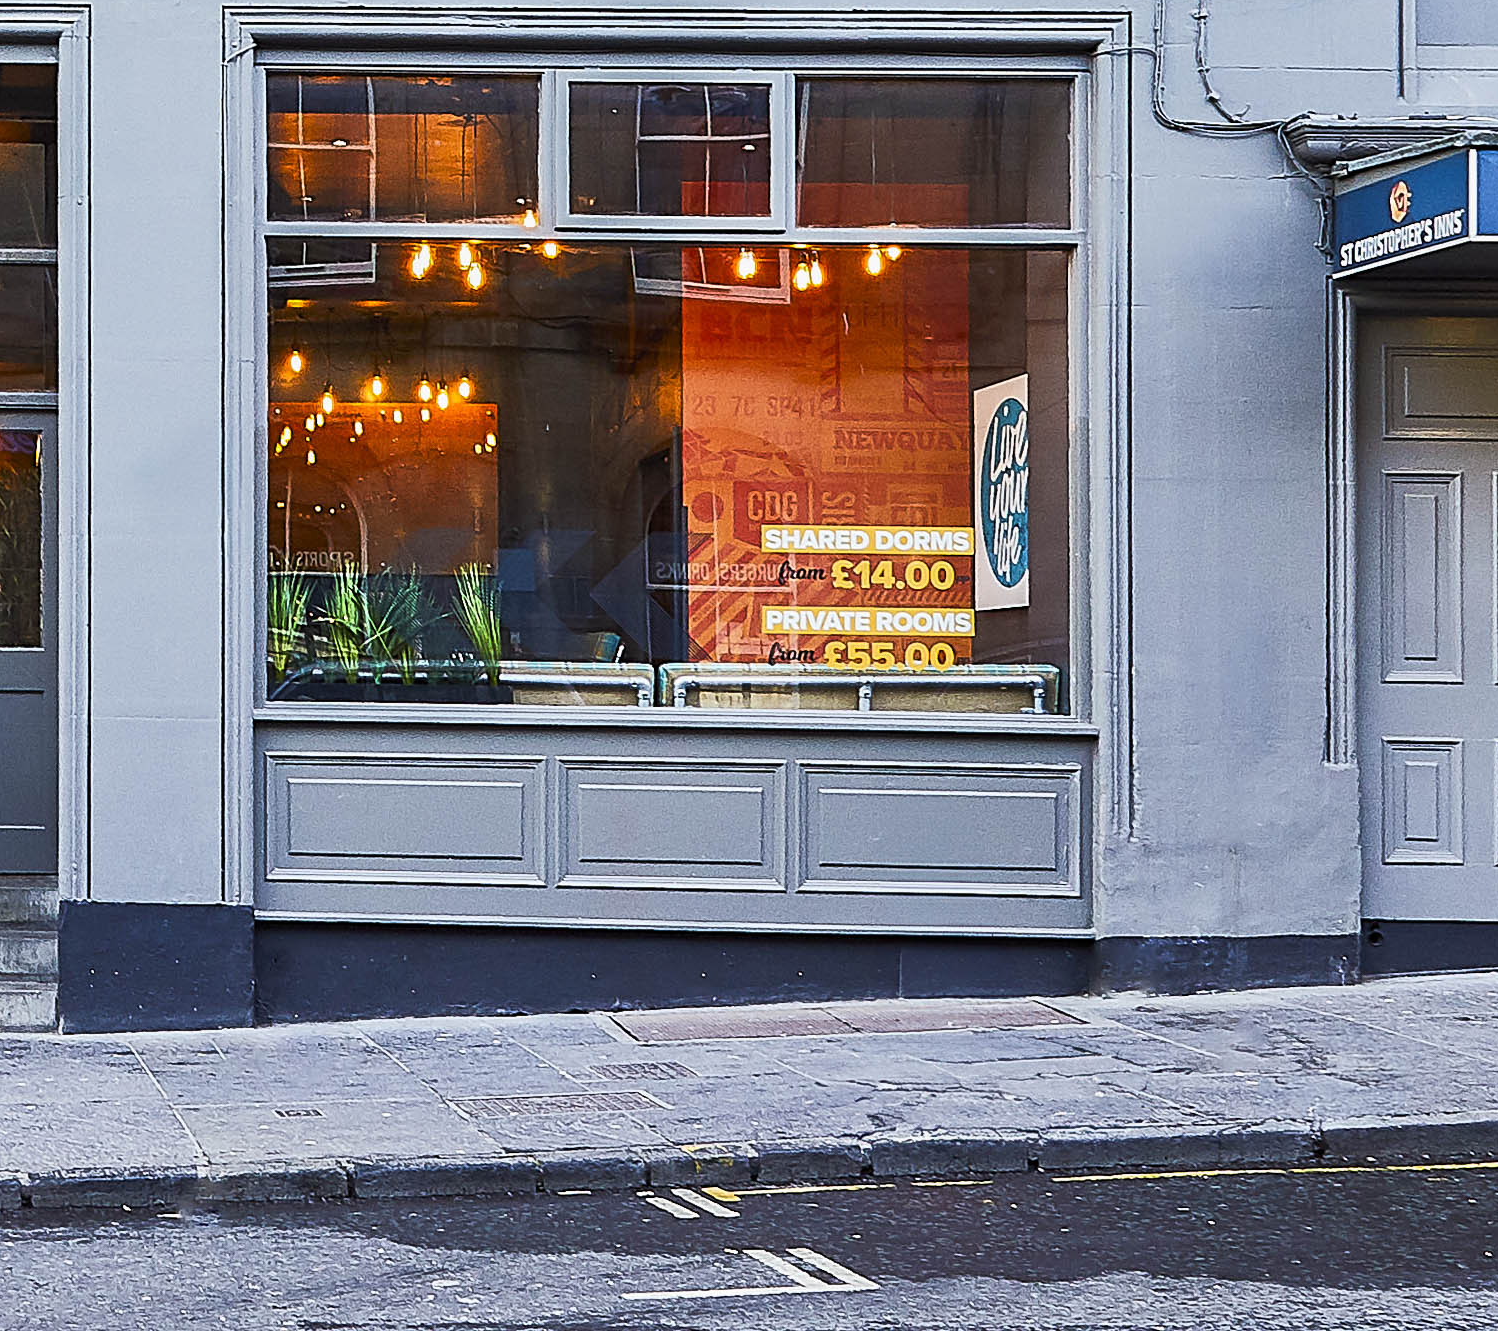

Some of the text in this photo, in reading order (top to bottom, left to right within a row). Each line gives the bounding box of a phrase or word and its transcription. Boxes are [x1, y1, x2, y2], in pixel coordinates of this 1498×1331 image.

[1340, 242, 1354, 267] ST
[990, 404, 1028, 482] Live
[747, 490, 800, 523] CDG
[765, 528, 971, 553] SHARED DORMS
[777, 559, 956, 591] from £14.00
[765, 609, 973, 633] PRIVATE ROOMS
[768, 640, 957, 672] from £55.00
